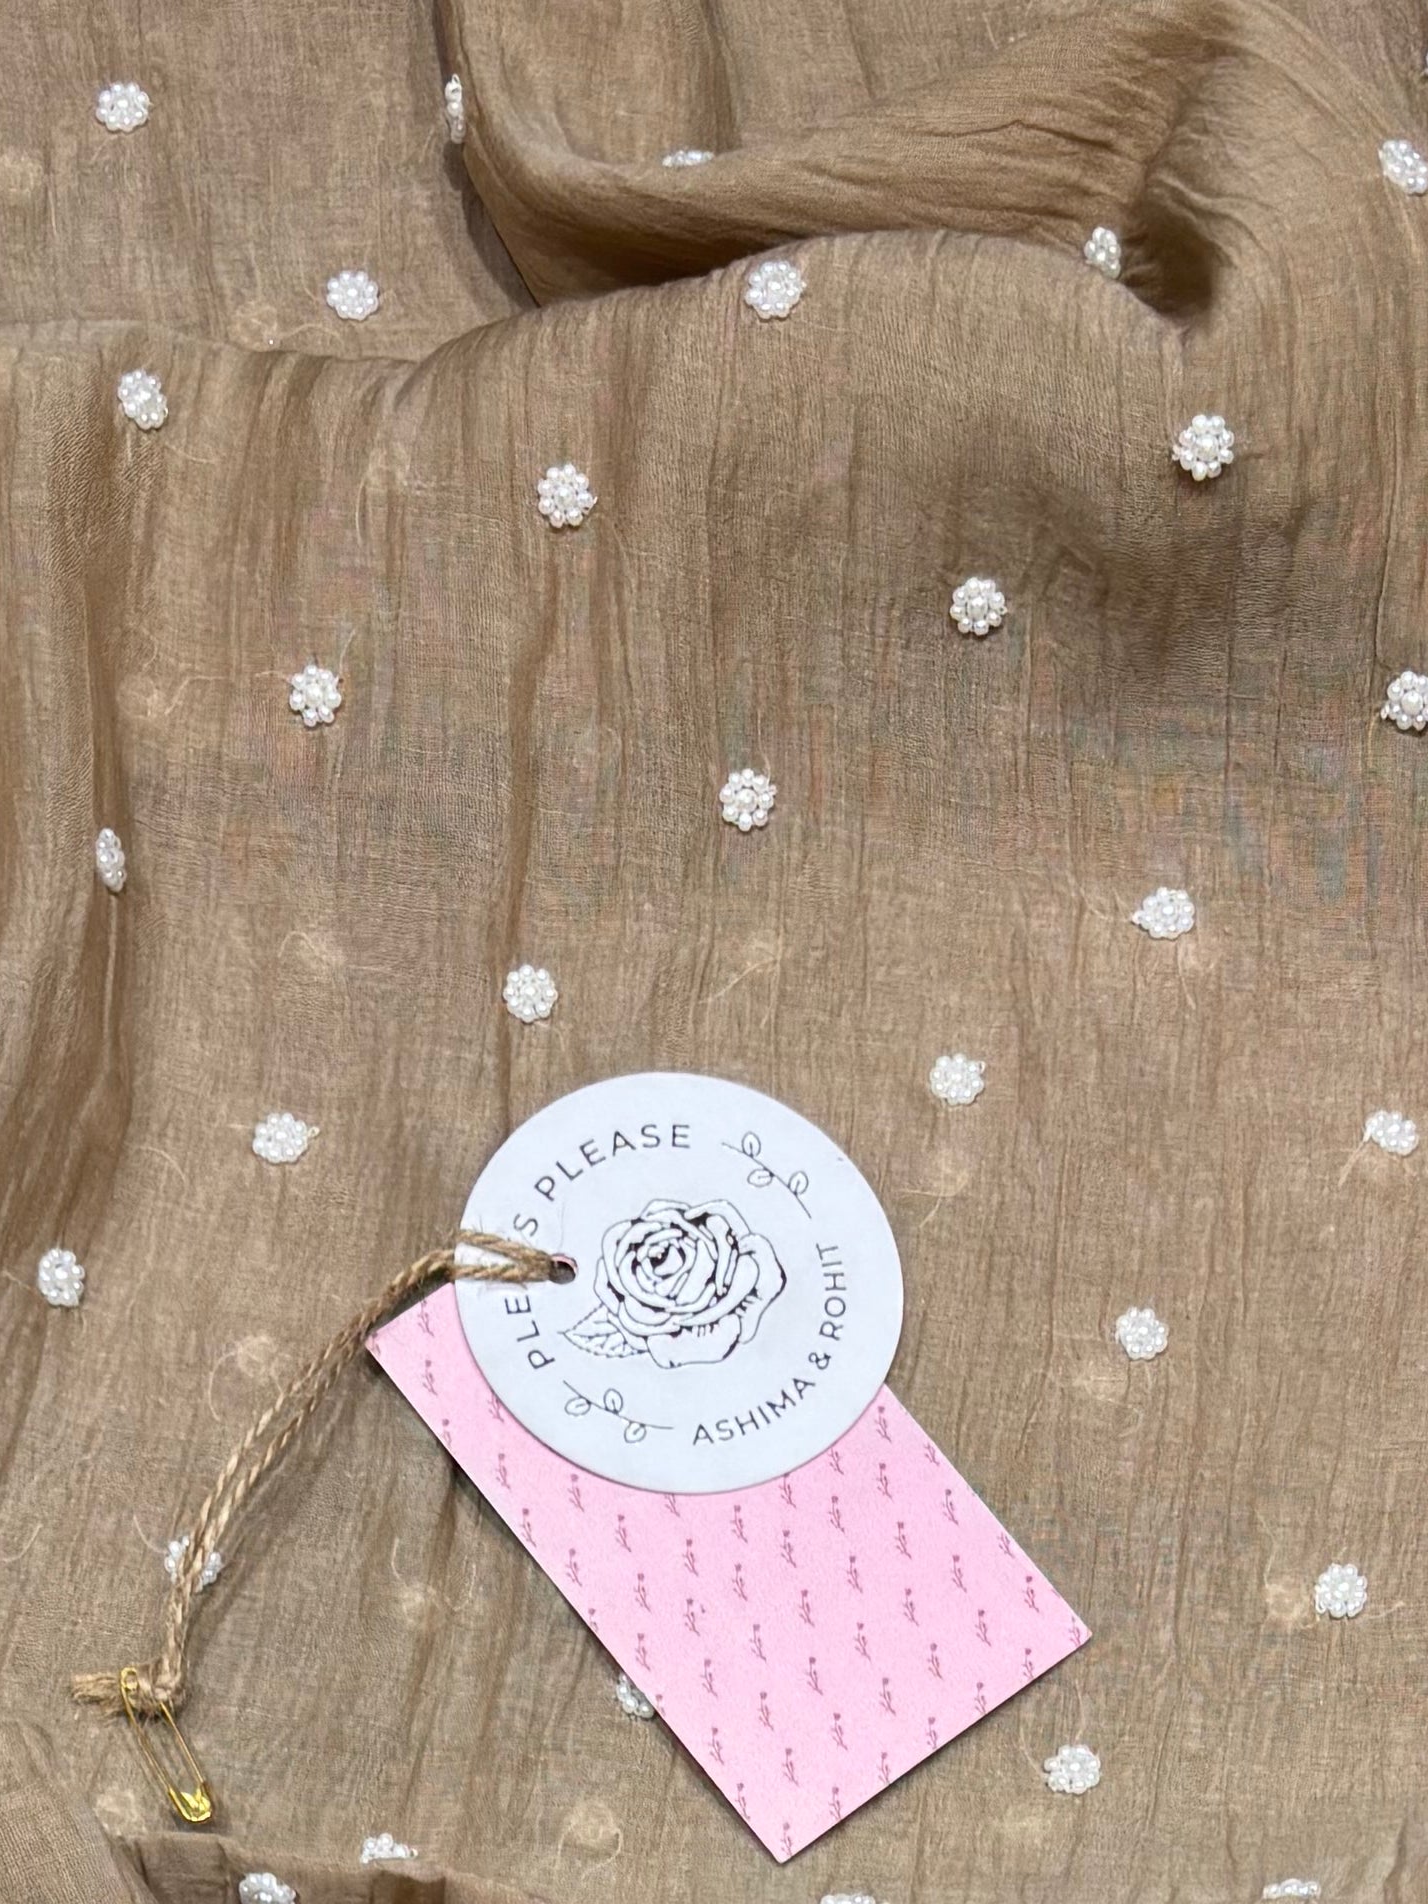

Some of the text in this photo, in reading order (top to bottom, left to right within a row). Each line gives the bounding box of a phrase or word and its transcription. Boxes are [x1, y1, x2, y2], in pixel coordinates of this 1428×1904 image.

[505, 1123, 692, 1370] PLES PLEASE
[692, 1241, 847, 1446] ASHIMA & ROHIT
